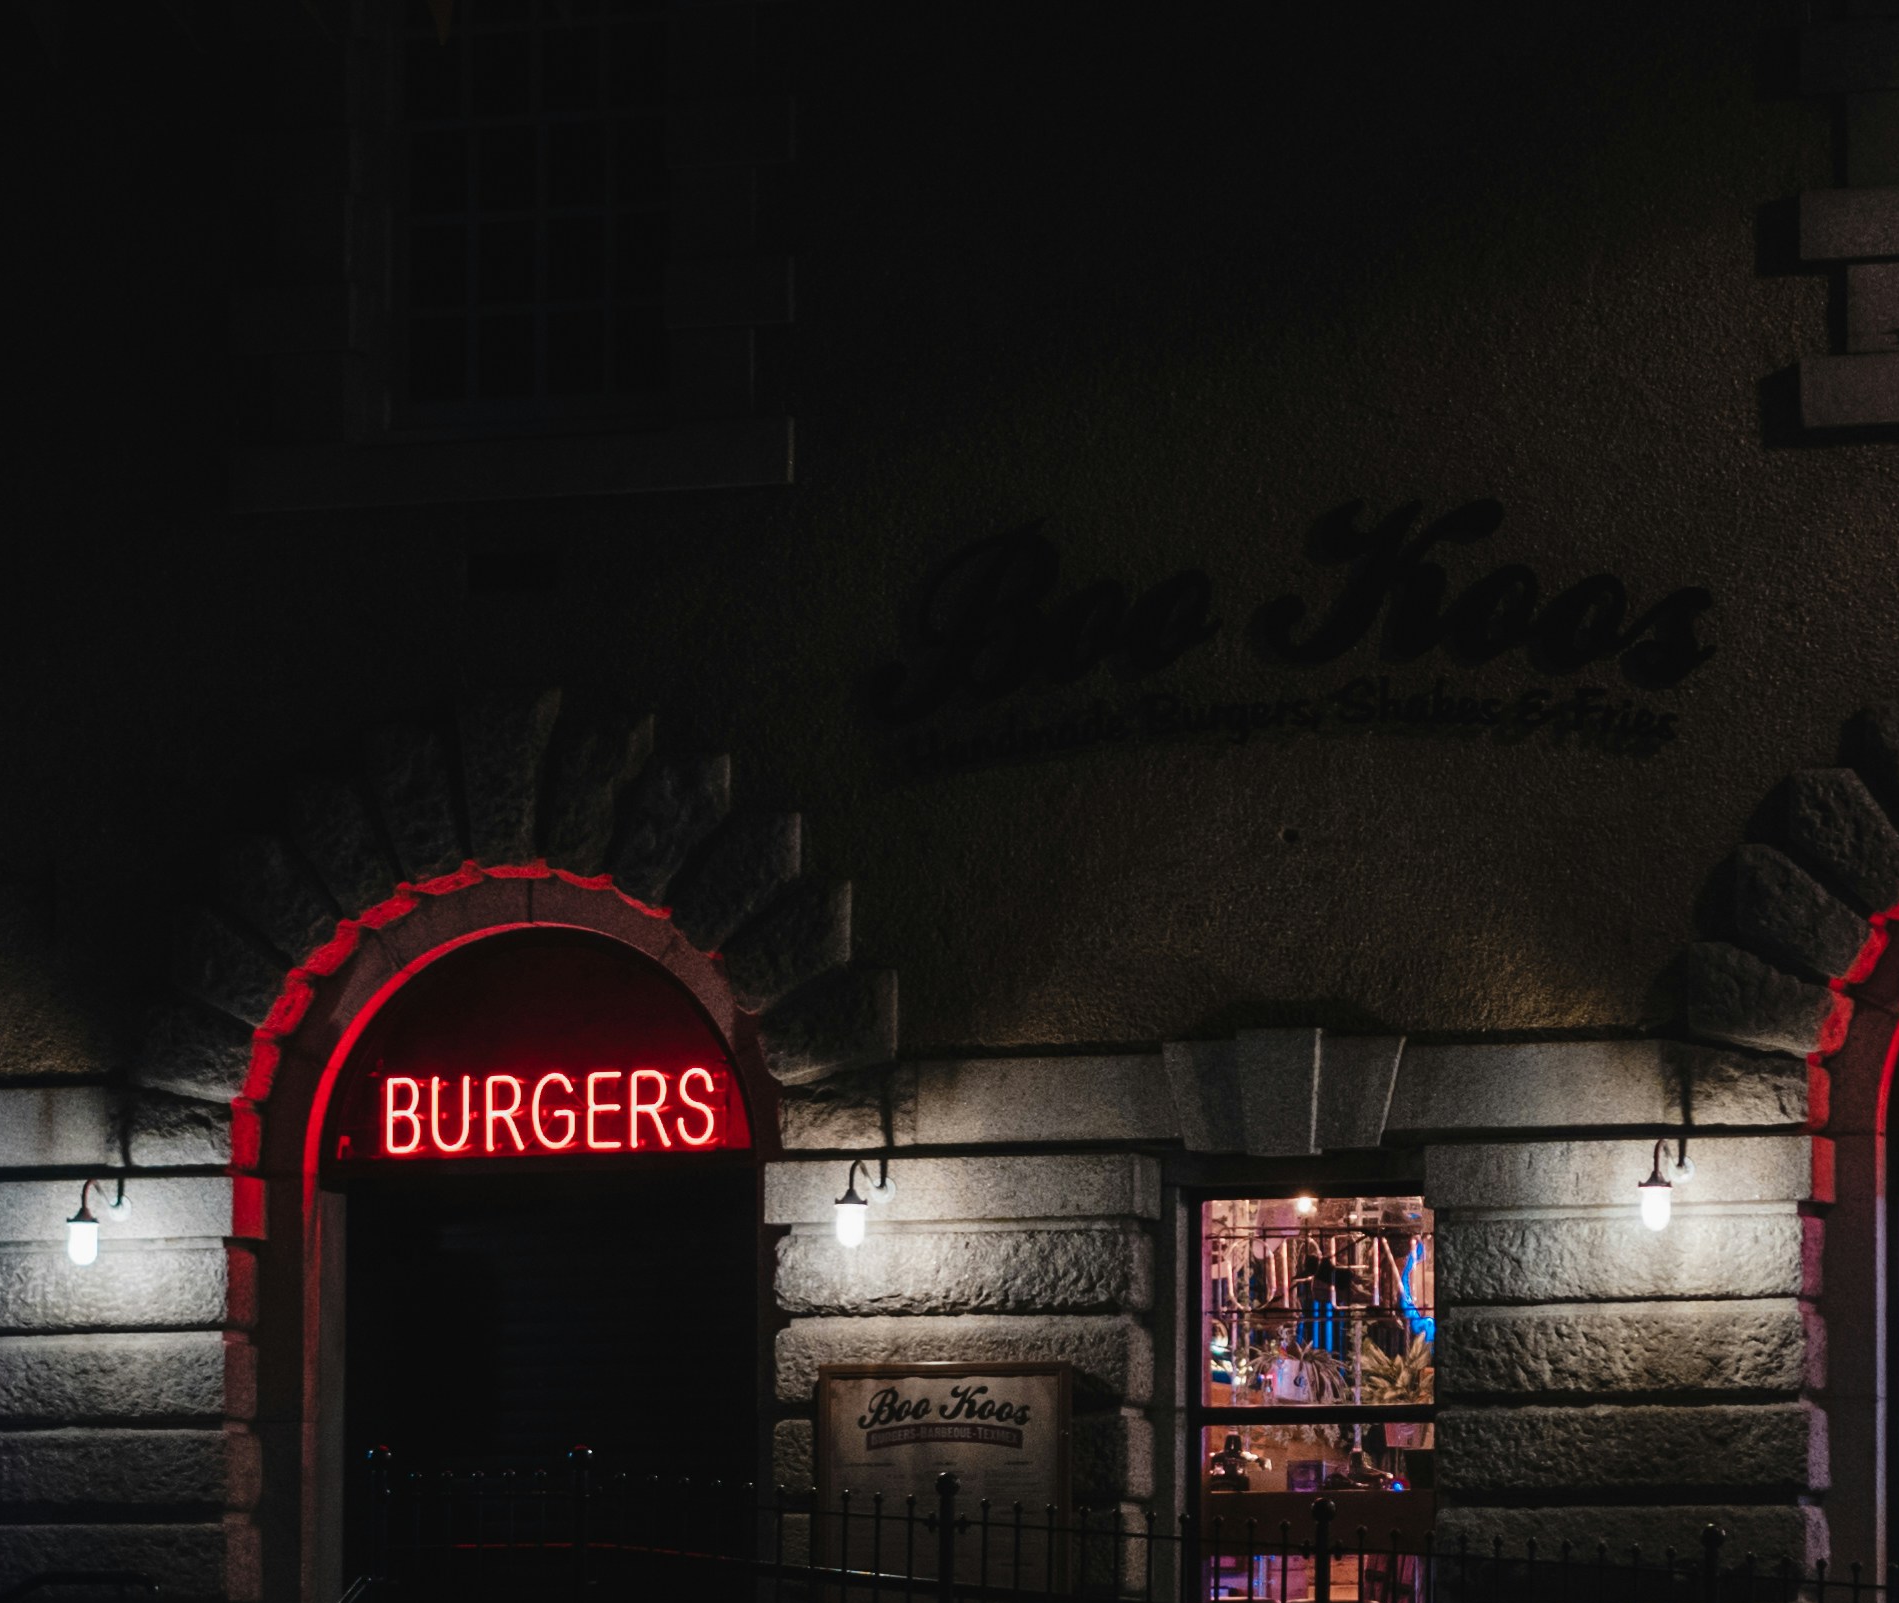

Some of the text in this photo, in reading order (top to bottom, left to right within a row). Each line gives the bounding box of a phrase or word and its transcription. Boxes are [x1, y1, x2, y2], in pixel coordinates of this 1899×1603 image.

[868, 498, 1716, 724] Boo Koos
[905, 704, 1127, 777] Handmade
[1336, 676, 1499, 727] Shakes
[1565, 688, 1679, 743] Fries
[386, 1067, 715, 1154] BURGERS
[858, 1384, 1031, 1430] Boo Koos
